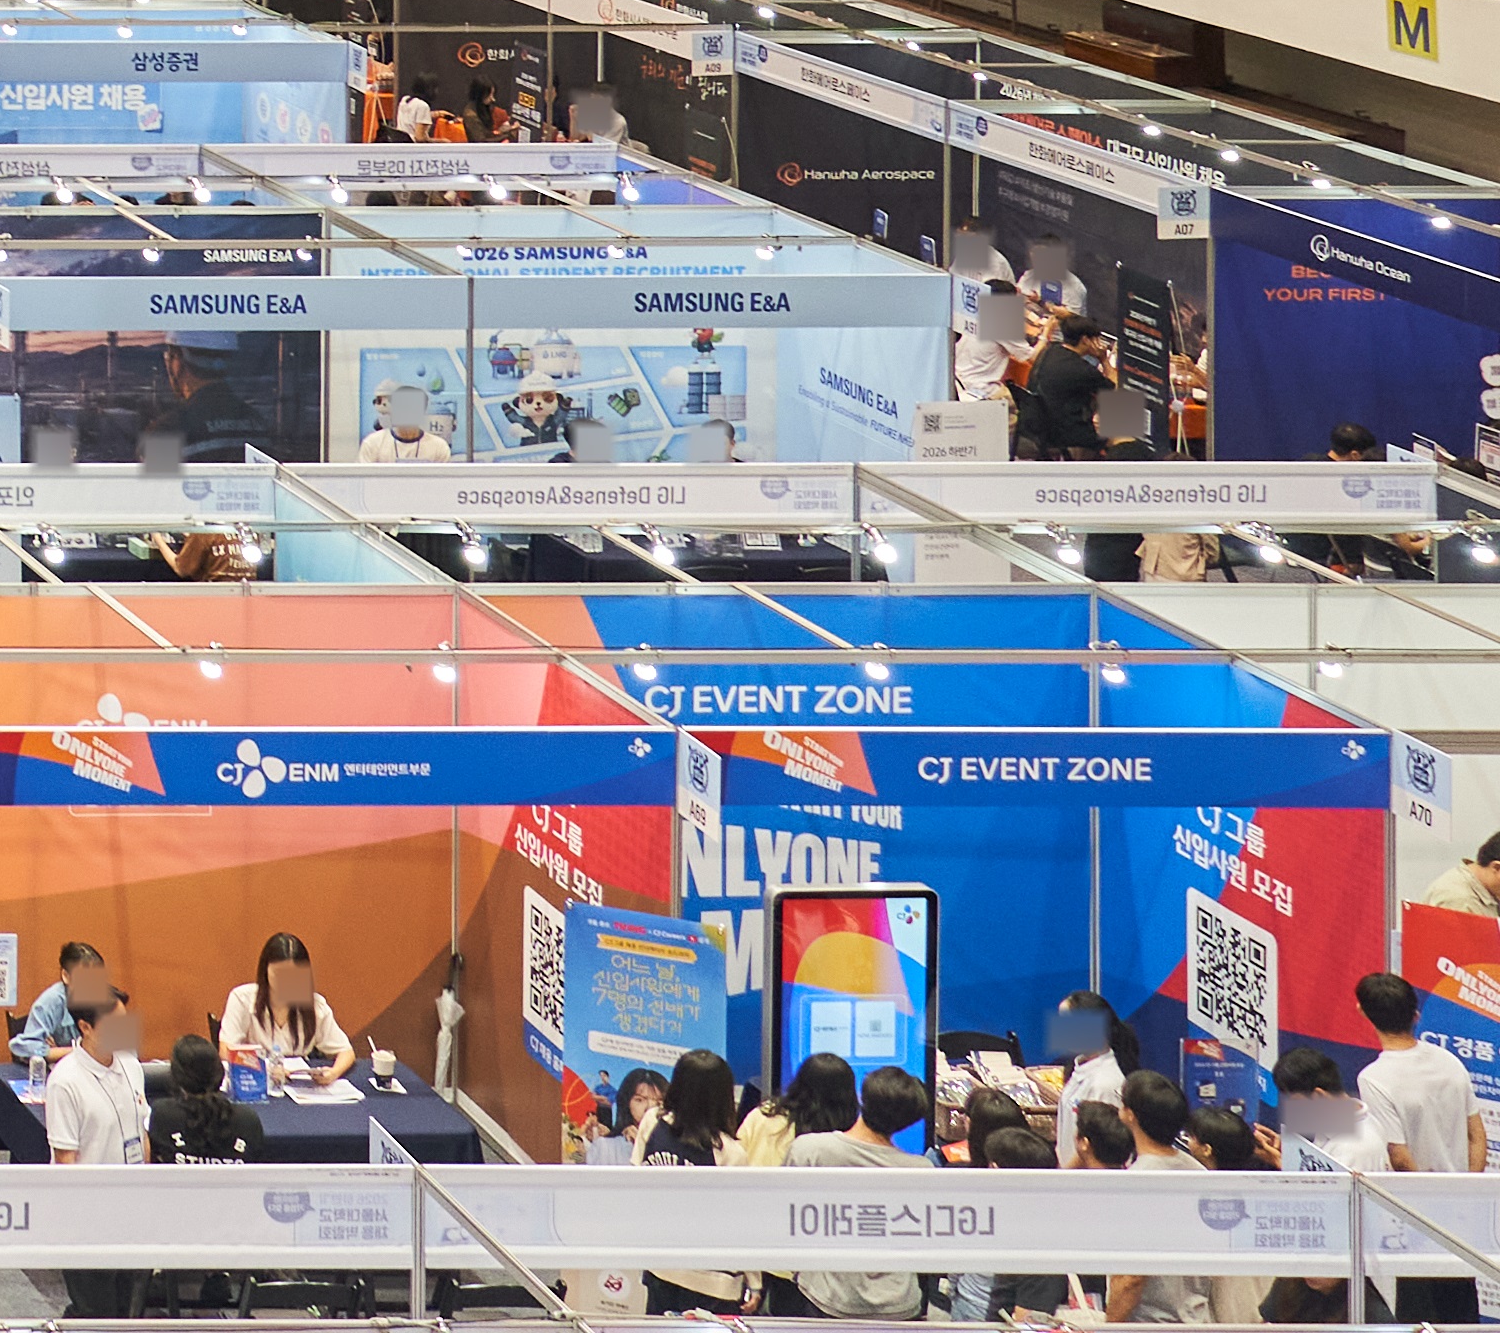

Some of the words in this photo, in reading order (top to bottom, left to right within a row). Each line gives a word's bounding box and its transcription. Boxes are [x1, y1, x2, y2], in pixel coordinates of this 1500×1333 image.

[1394, 2, 1430, 53] M
[132, 52, 198, 72] 삼성증권
[804, 167, 858, 181] Hanwha
[861, 169, 935, 181] Aerospace
[1028, 140, 1115, 184] 한화에어로스페이스
[1175, 224, 1194, 235] A07
[1331, 246, 1374, 270] Hanwha
[1376, 261, 1411, 283] Ocean
[635, 292, 743, 312] SAMSUNG
[751, 293, 790, 312] E&A
[1264, 288, 1323, 301] YOUR
[644, 686, 684, 716] CJ
[693, 686, 810, 714] EVENT
[815, 685, 912, 714] ZONE
[289, 763, 339, 782] ENM
[344, 763, 430, 776] 엔터테인먼트부문
[690, 800, 706, 827] A69
[1410, 801, 1432, 826] A70
[1224, 820, 1265, 859] 그룹
[1172, 821, 1248, 895] 신입사원
[1252, 869, 1292, 917] 모집
